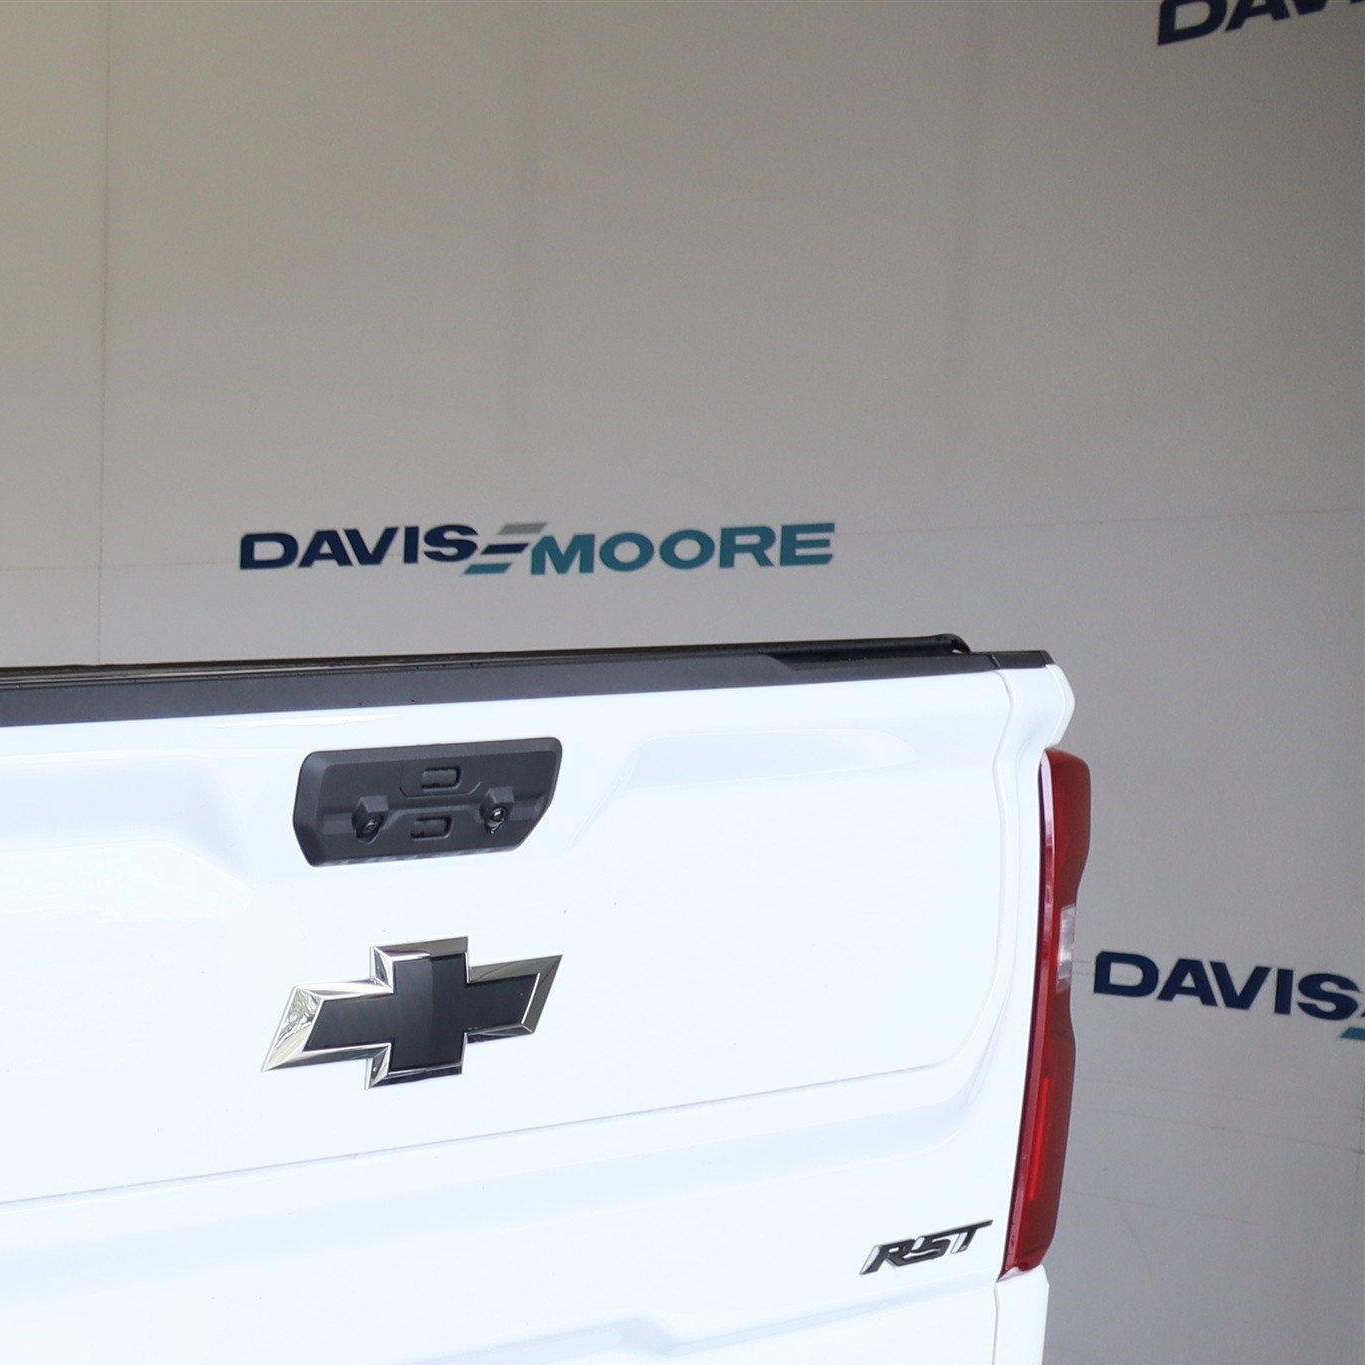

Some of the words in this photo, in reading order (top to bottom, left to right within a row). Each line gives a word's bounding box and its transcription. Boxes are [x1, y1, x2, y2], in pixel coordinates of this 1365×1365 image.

[238, 523, 479, 571] DAVIS
[530, 522, 836, 576] MOORE
[1093, 950, 1361, 1021] DAVIS
[859, 1219, 994, 1276] RST
